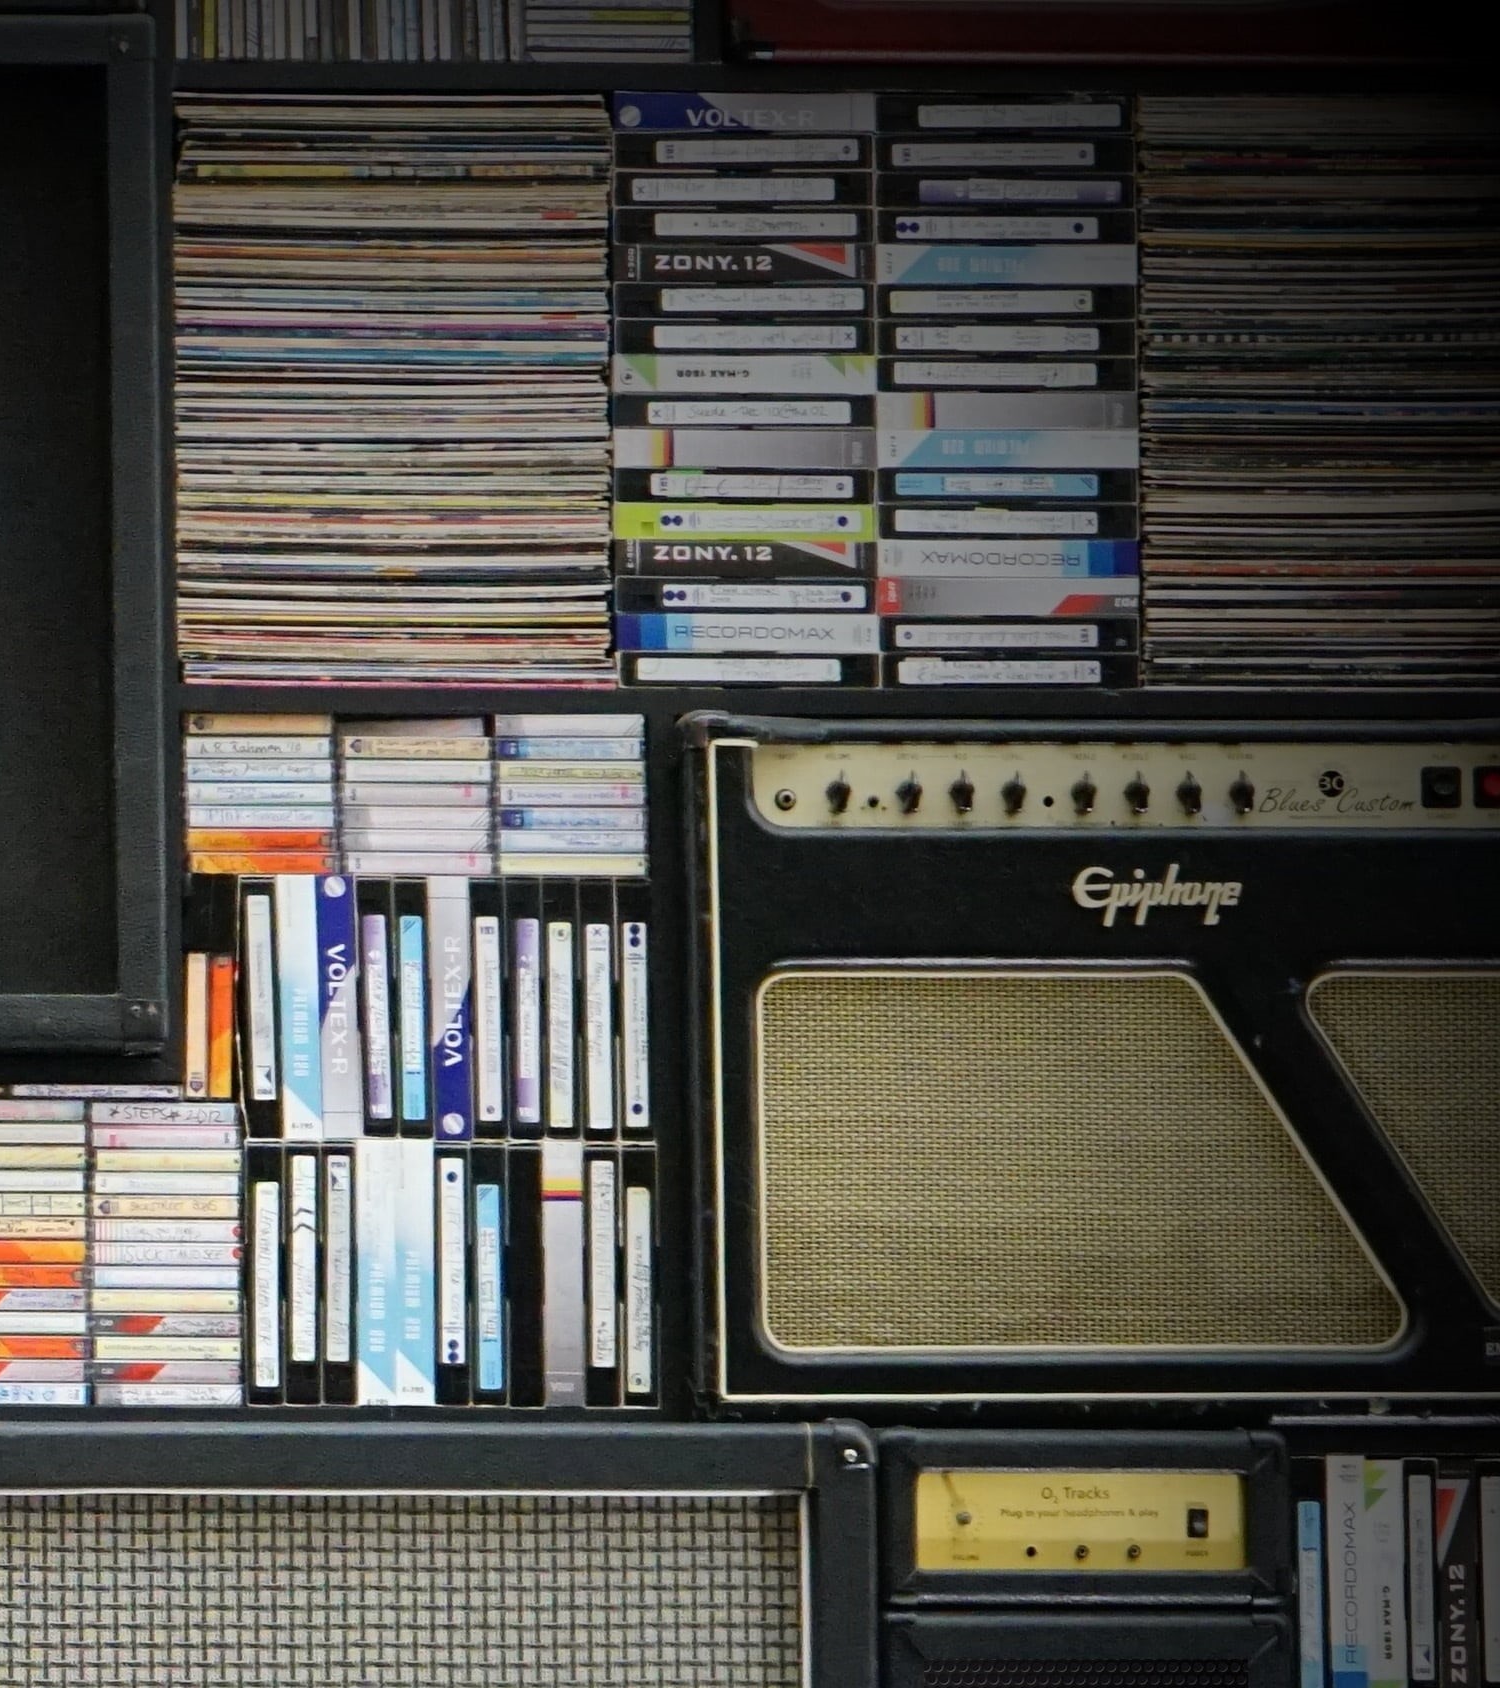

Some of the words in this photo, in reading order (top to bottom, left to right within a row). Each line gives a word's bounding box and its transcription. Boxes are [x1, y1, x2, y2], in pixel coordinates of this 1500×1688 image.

[686, 109, 814, 128] VOLTEX-R
[655, 254, 772, 272] ZONY.12
[654, 545, 772, 562] ZONY.12
[921, 551, 1080, 567] RECORDOMAX
[675, 624, 836, 641] RECORDOMAX
[1258, 787, 1324, 814] Blues
[1336, 787, 1417, 814] Custom
[1071, 862, 1243, 927] Epiphone
[325, 943, 348, 1076] VOLTEX-R
[443, 936, 463, 1068] VOLTEX-R
[1063, 1486, 1110, 1501] Tracks
[1345, 1502, 1358, 1665] RECORDOMAX
[1450, 1562, 1468, 1684] ZONY.12
